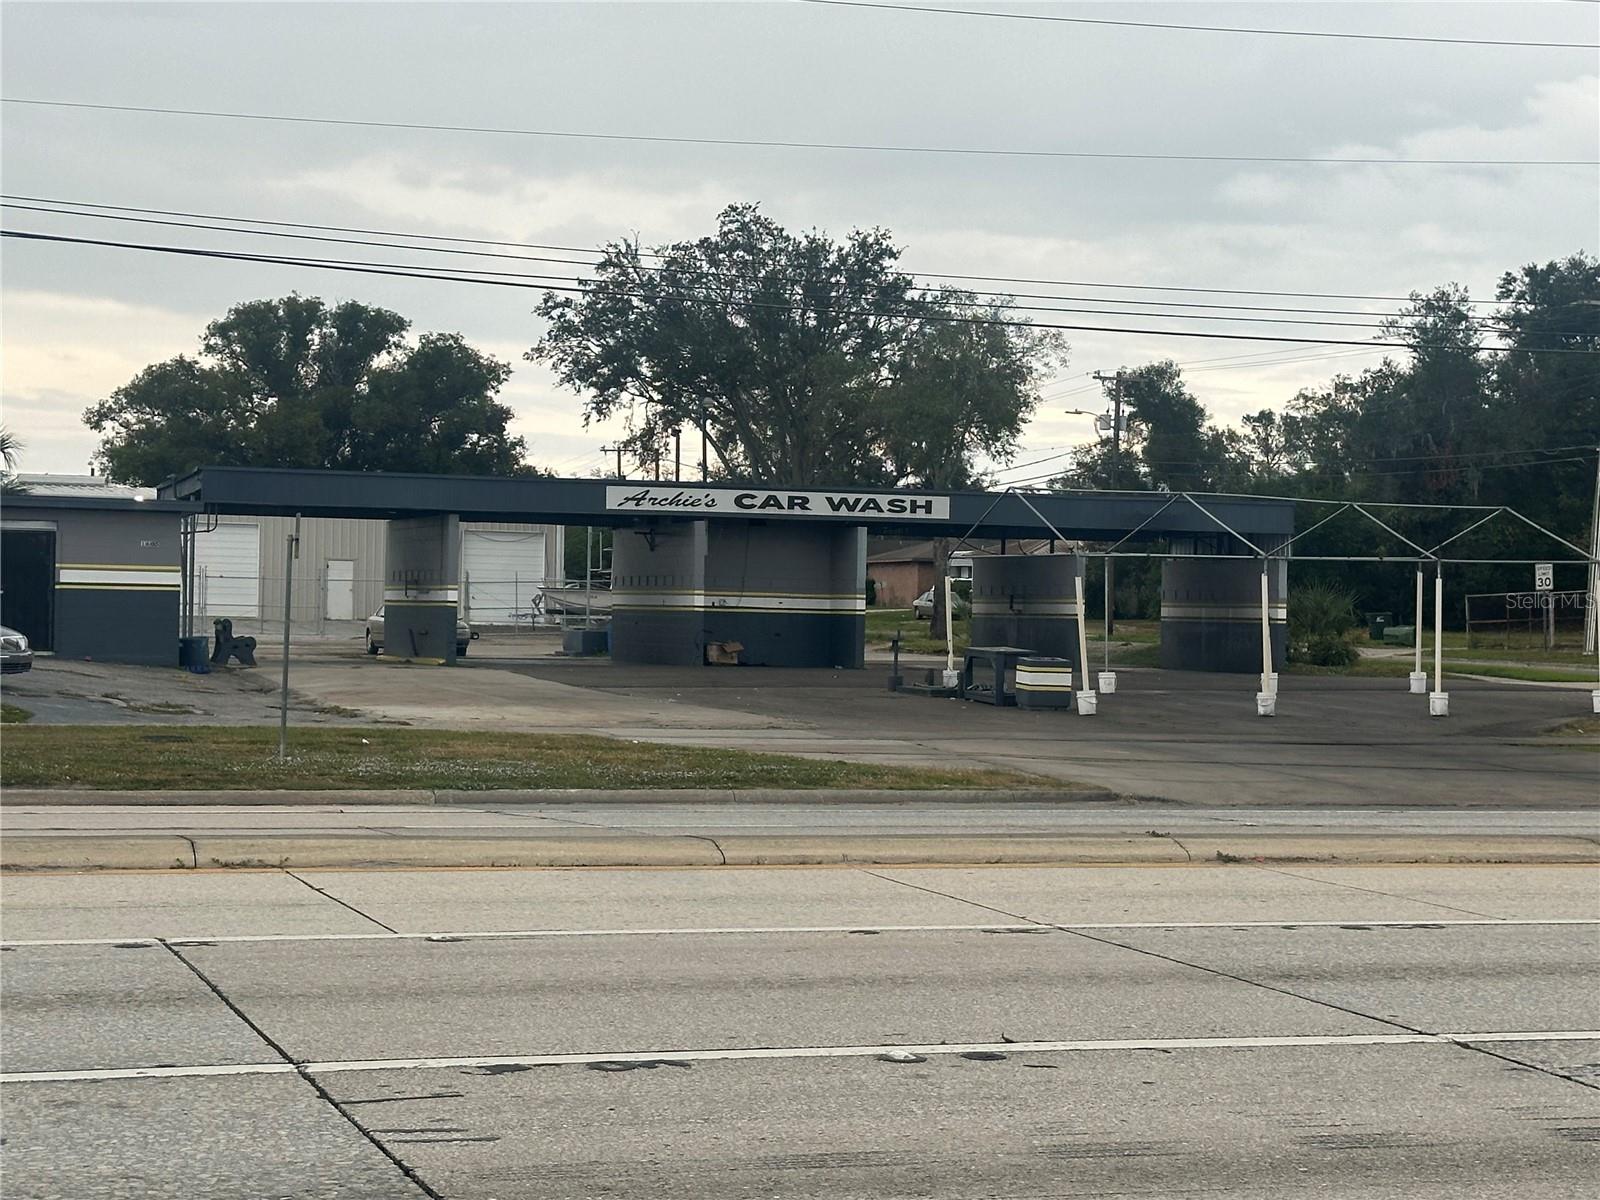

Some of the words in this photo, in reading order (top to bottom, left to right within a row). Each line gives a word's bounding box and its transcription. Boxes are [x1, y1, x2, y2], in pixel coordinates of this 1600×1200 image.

[617, 489, 718, 509] Archie's
[733, 493, 813, 511] CAR
[824, 495, 933, 515] WASH
[1537, 577, 1551, 588] 30
